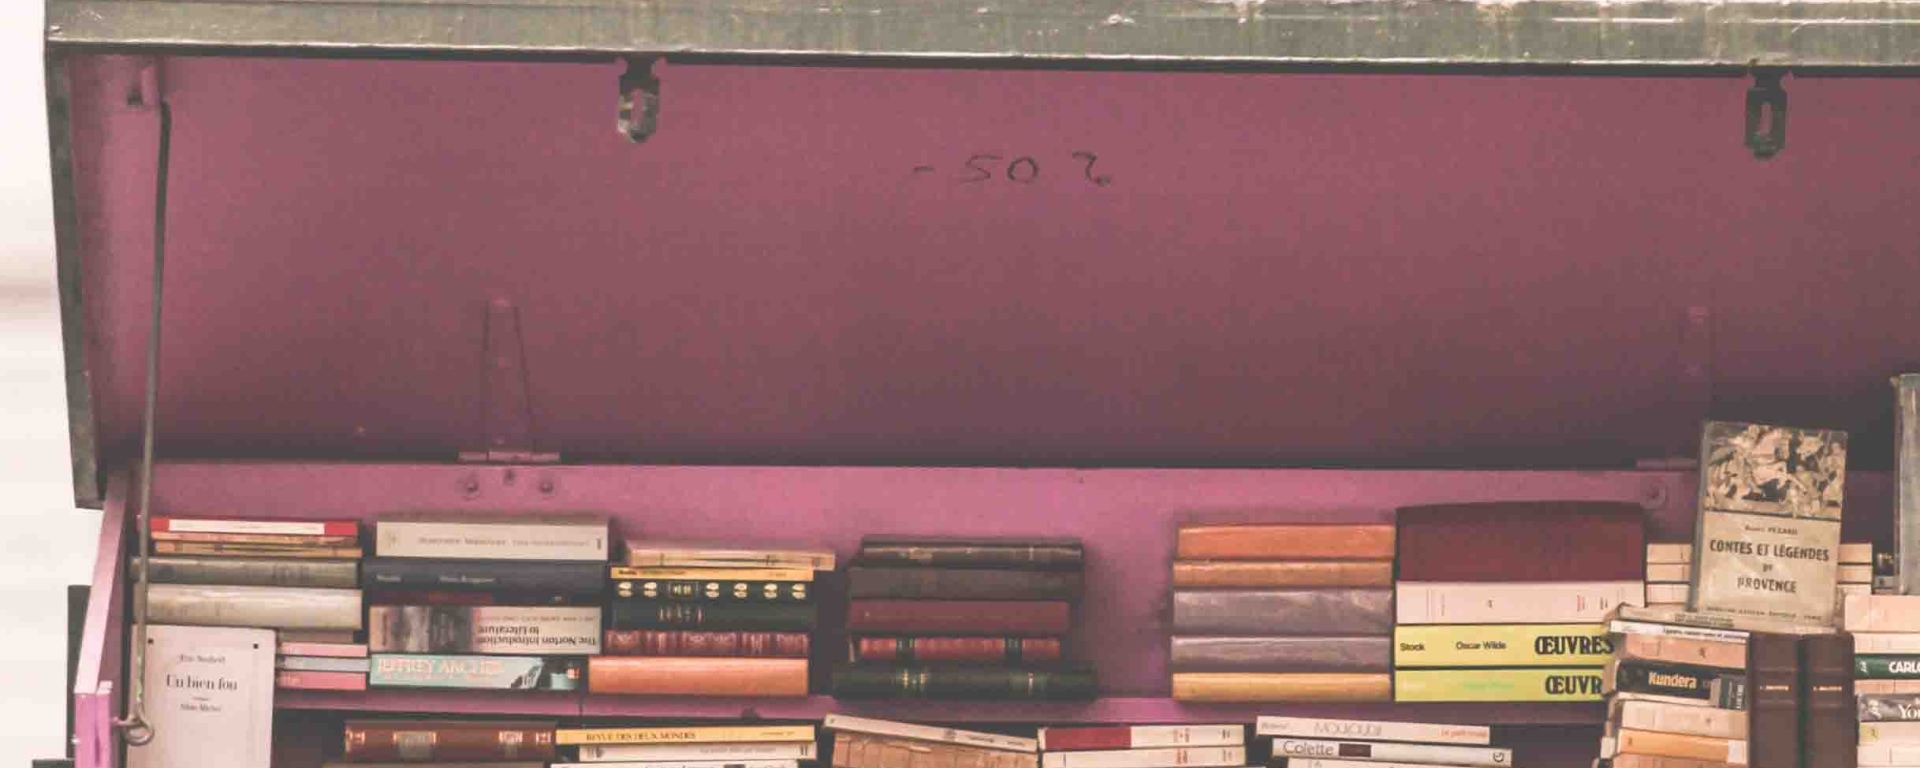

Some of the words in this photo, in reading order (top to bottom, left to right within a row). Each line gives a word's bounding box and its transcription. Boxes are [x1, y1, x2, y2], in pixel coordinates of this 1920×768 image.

[1709, 539, 1753, 555] CONTES
[1756, 543, 1769, 557] ET
[1773, 544, 1830, 562] LÉGENDES
[1736, 576, 1798, 594] PROVENCE
[477, 625, 526, 635] Literature
[528, 625, 540, 635] to
[477, 634, 538, 646] Introduction
[540, 635, 576, 646] Norton
[1399, 642, 1426, 652] Stock
[1455, 641, 1481, 651] Oscar
[1482, 641, 1507, 651] Wilde
[1534, 635, 1616, 656] ŒUVRES
[166, 674, 184, 688] Un
[186, 675, 215, 690] bien
[218, 677, 238, 690] fou
[1648, 672, 1697, 690] Kundera
[586, 732, 613, 741] REVUE
[634, 731, 656, 740] DEUX
[659, 731, 696, 741] MONDES
[1283, 740, 1334, 757] Colette
